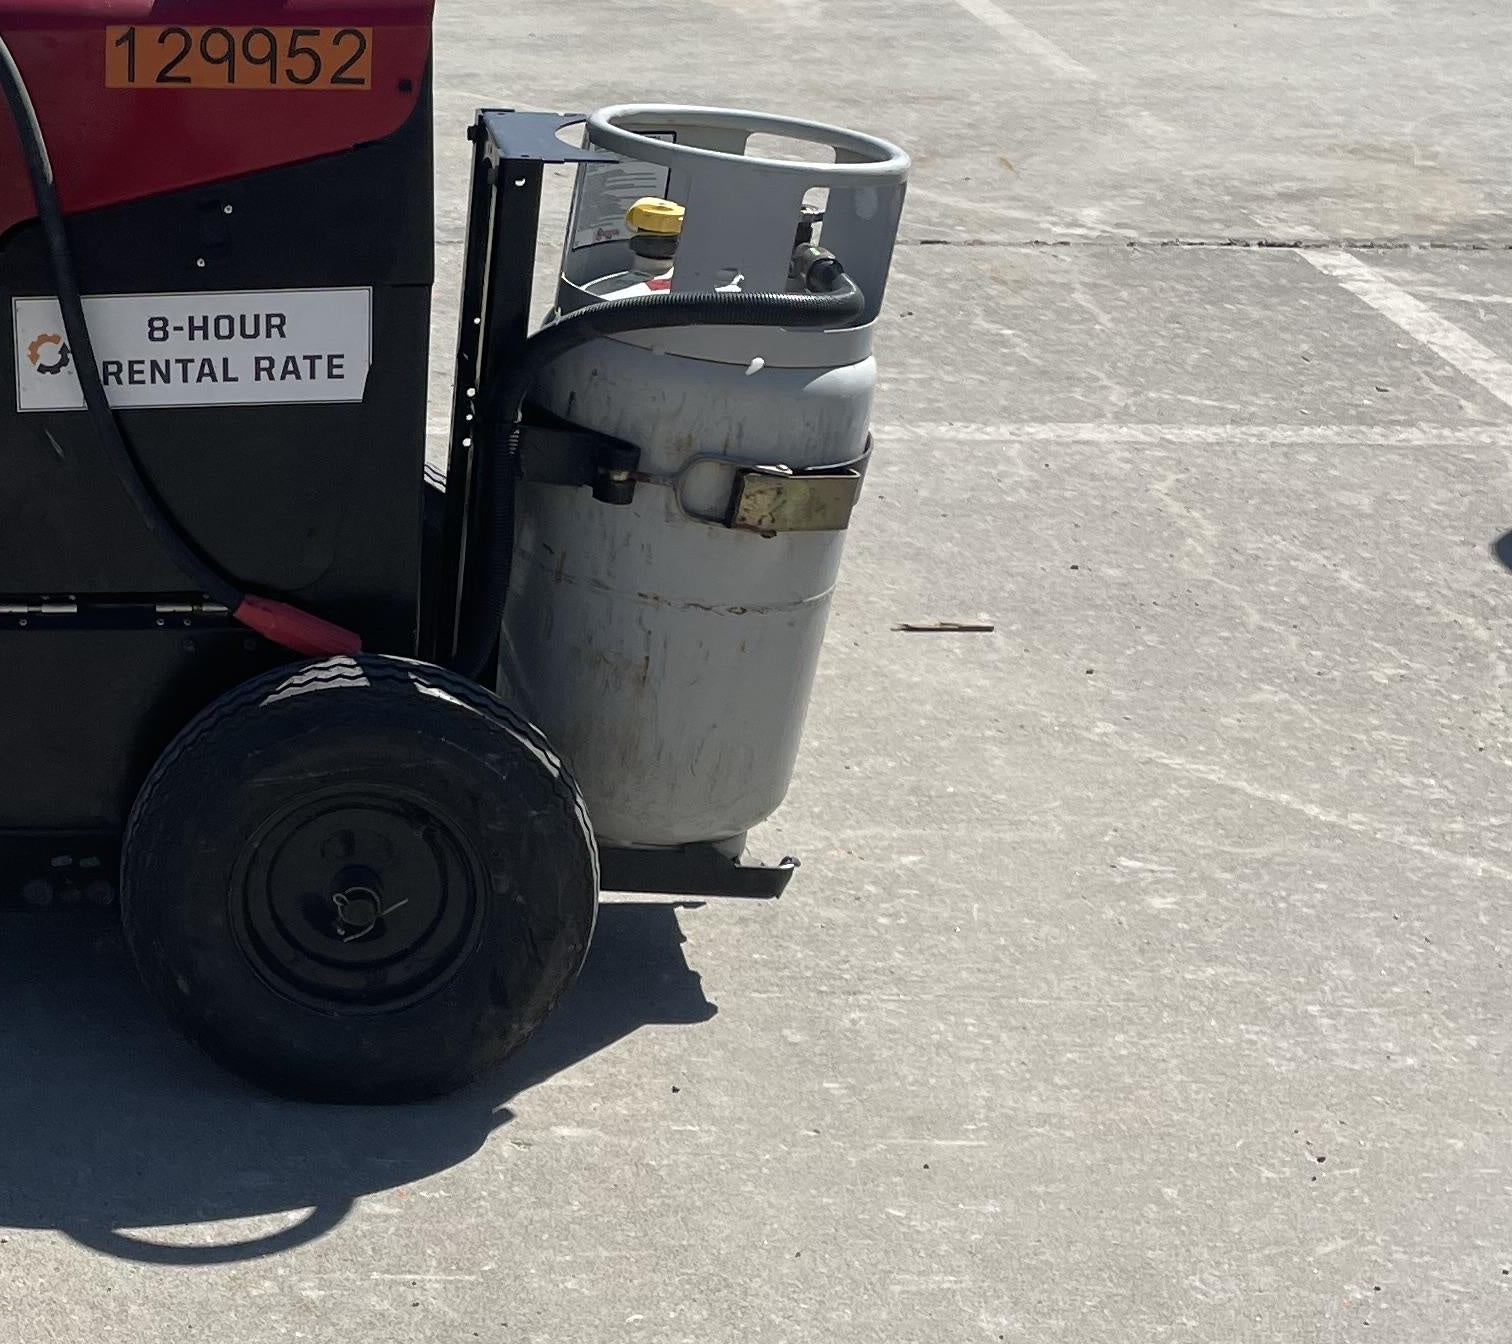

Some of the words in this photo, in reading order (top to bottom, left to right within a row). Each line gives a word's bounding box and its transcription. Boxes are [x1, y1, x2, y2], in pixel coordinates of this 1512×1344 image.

[115, 27, 367, 85] 129952
[147, 312, 287, 342] 8-HOUR
[102, 357, 240, 386] RENTAL
[253, 353, 345, 382] RATE
